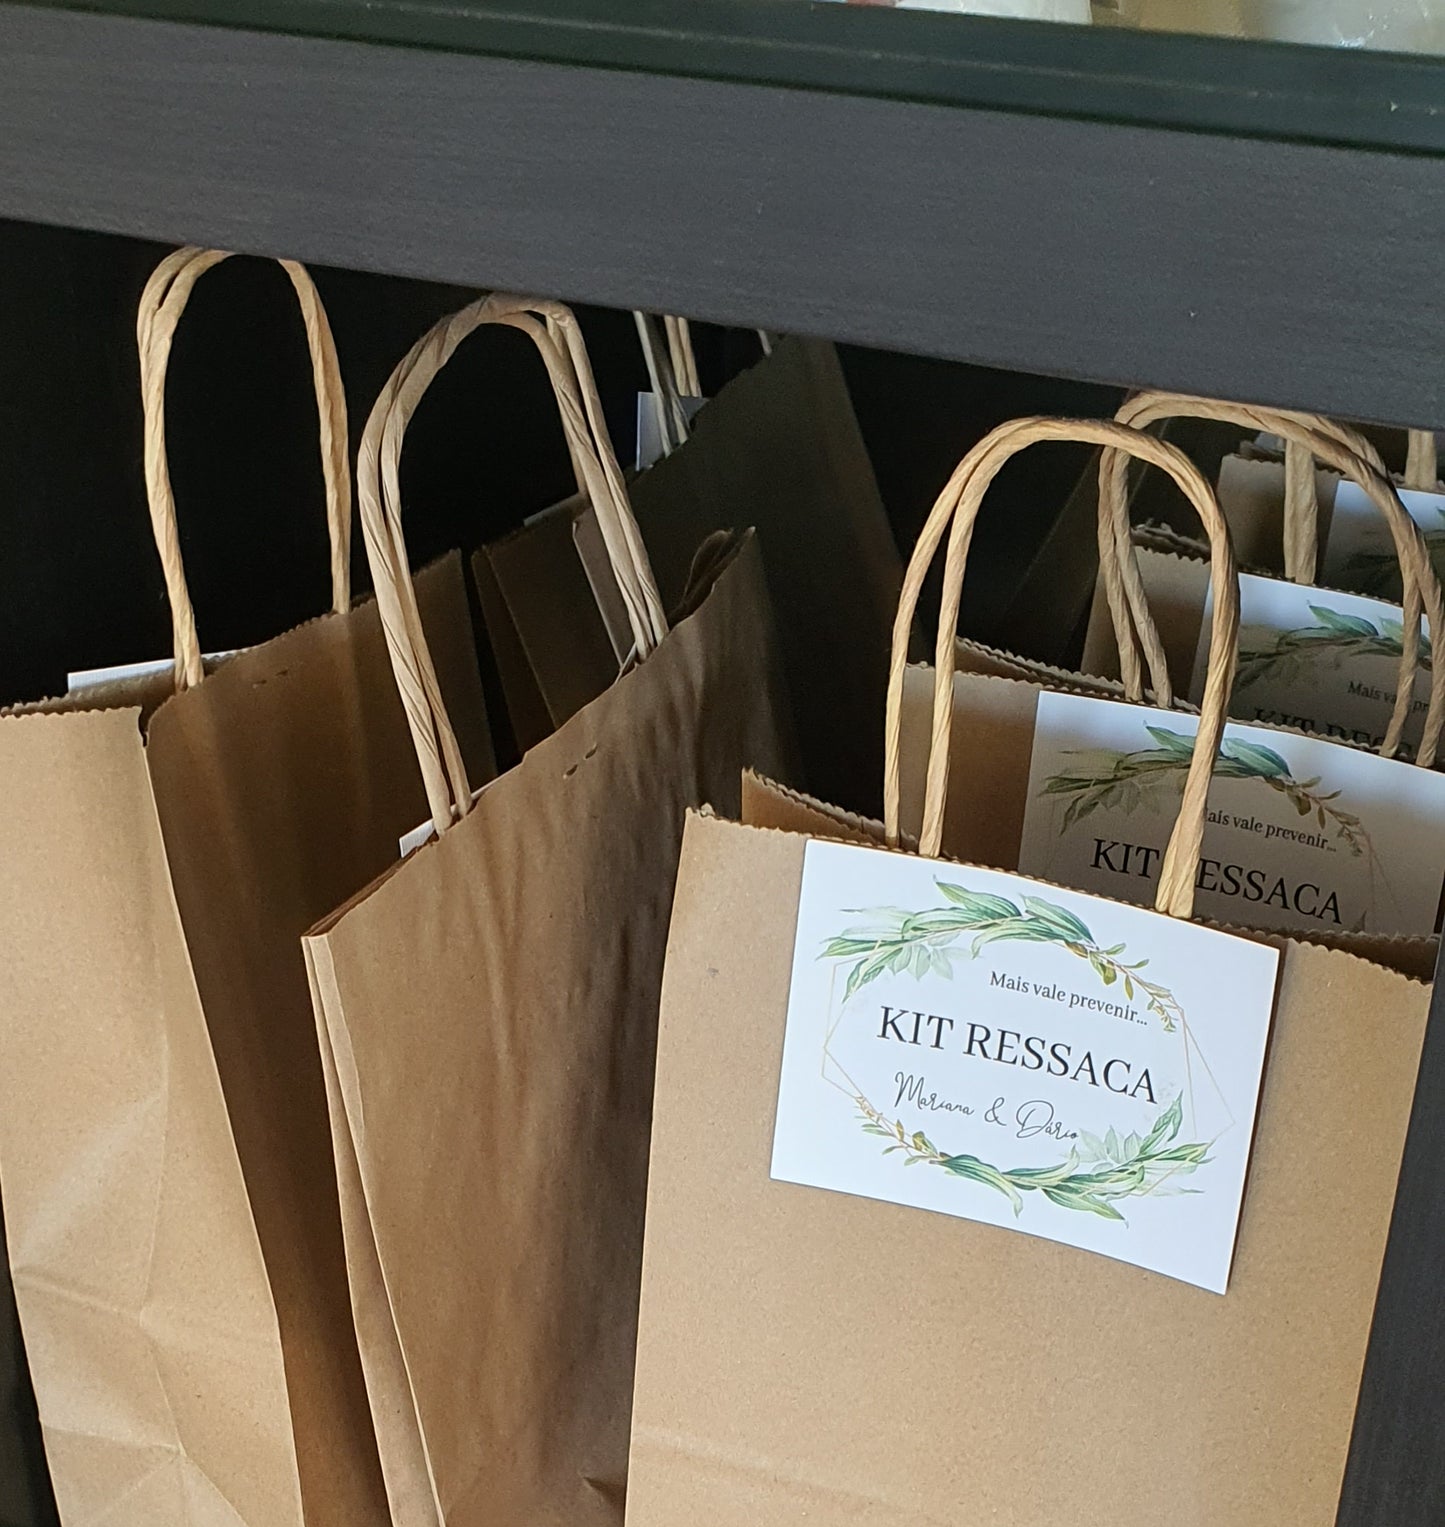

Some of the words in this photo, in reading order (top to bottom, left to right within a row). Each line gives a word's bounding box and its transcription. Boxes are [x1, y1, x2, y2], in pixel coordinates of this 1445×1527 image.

[1204, 808, 1230, 826] ais
[1232, 816, 1263, 833] vale
[1265, 824, 1337, 852] prevenir...
[1090, 838, 1160, 879] KIT
[1195, 857, 1343, 925] ESSACA
[989, 971, 1029, 993] Mais
[1033, 980, 1066, 1002] vale
[1069, 989, 1148, 1026] prevenir...
[876, 1006, 954, 1050] KIT
[963, 1023, 1158, 1104] RESSACA
[894, 1071, 974, 1116] Mariana
[984, 1097, 1007, 1126] &
